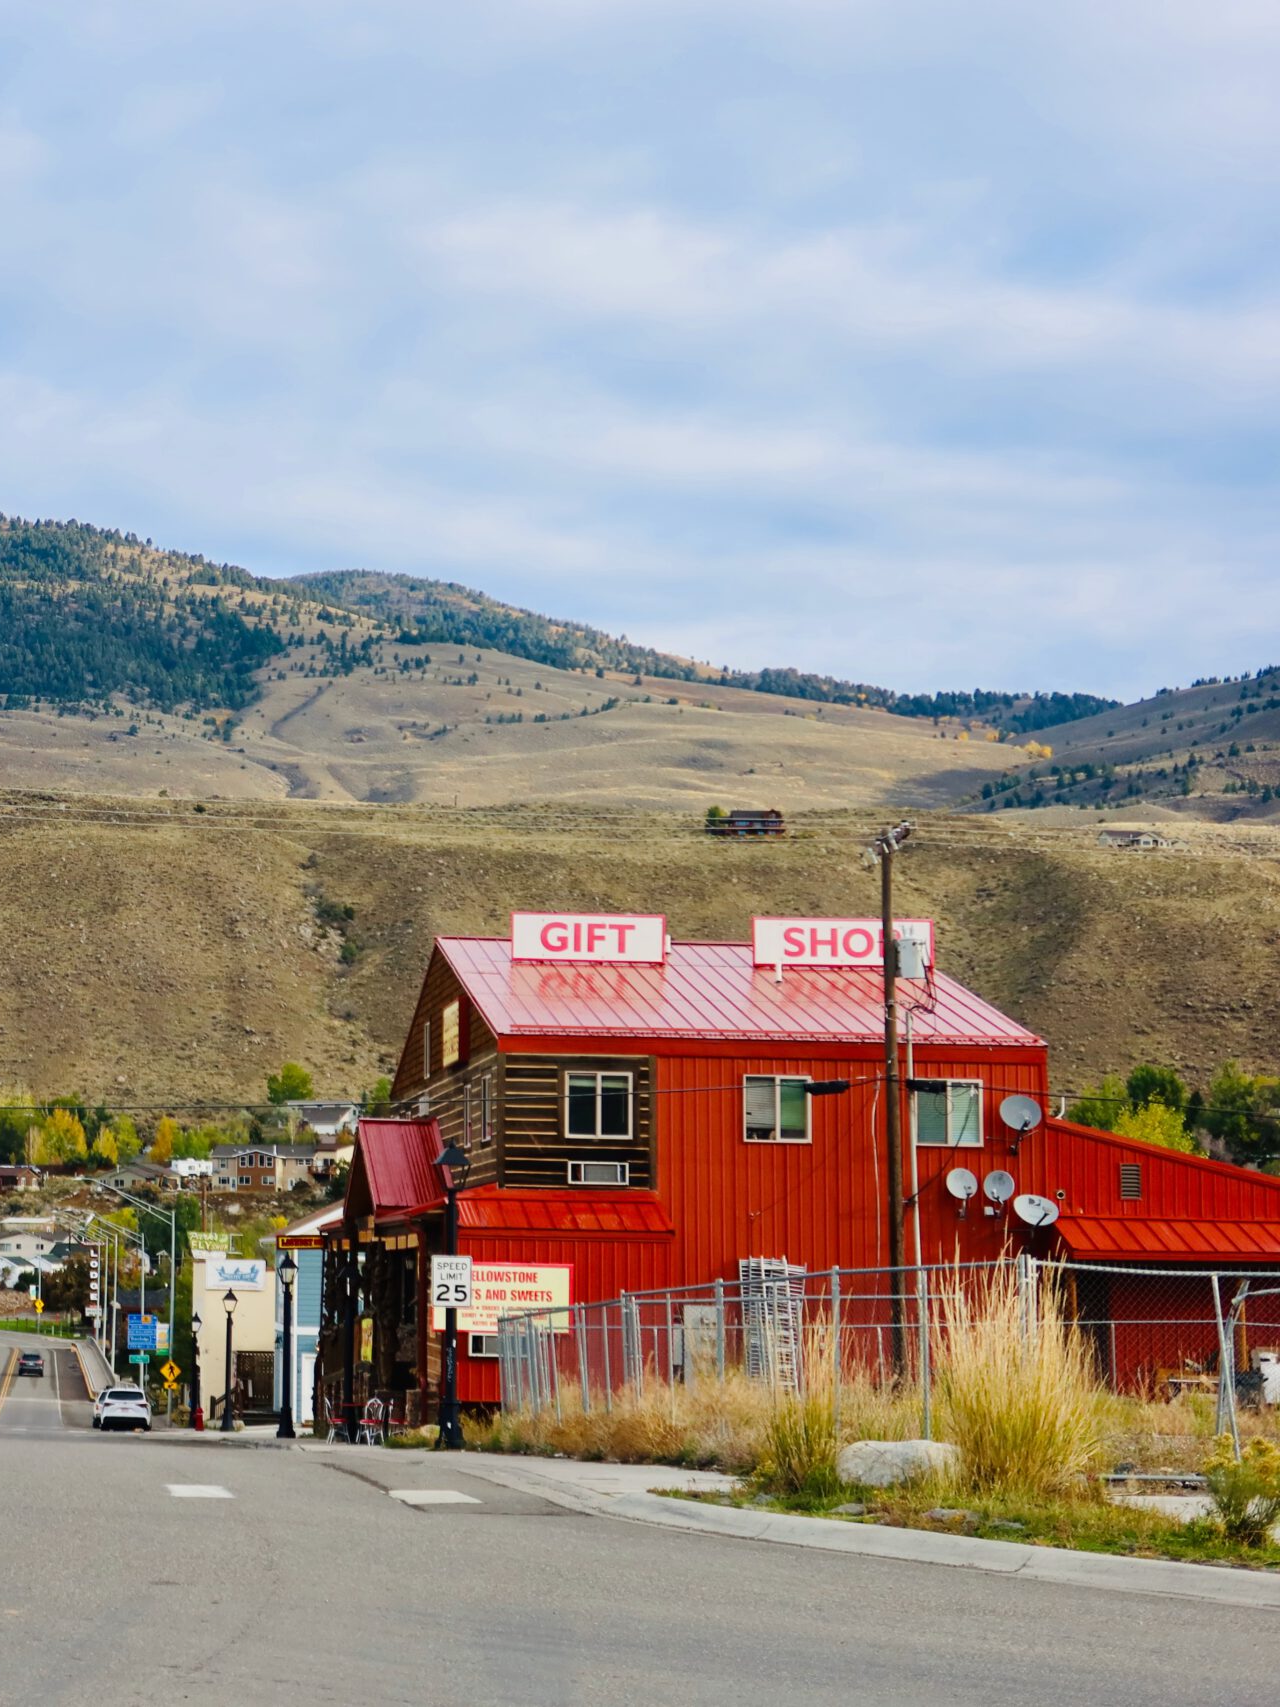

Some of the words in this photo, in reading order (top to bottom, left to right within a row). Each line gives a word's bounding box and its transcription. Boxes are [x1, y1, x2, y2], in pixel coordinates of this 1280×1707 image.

[540, 922, 636, 954] GIFT
[436, 1262, 468, 1271] SPEED
[440, 1273, 463, 1281] LIMIT
[471, 1270, 538, 1284] ELLOWSTONE
[436, 1284, 468, 1302] 25
[485, 1289, 507, 1301] AND
[510, 1290, 553, 1303] SWEETS
